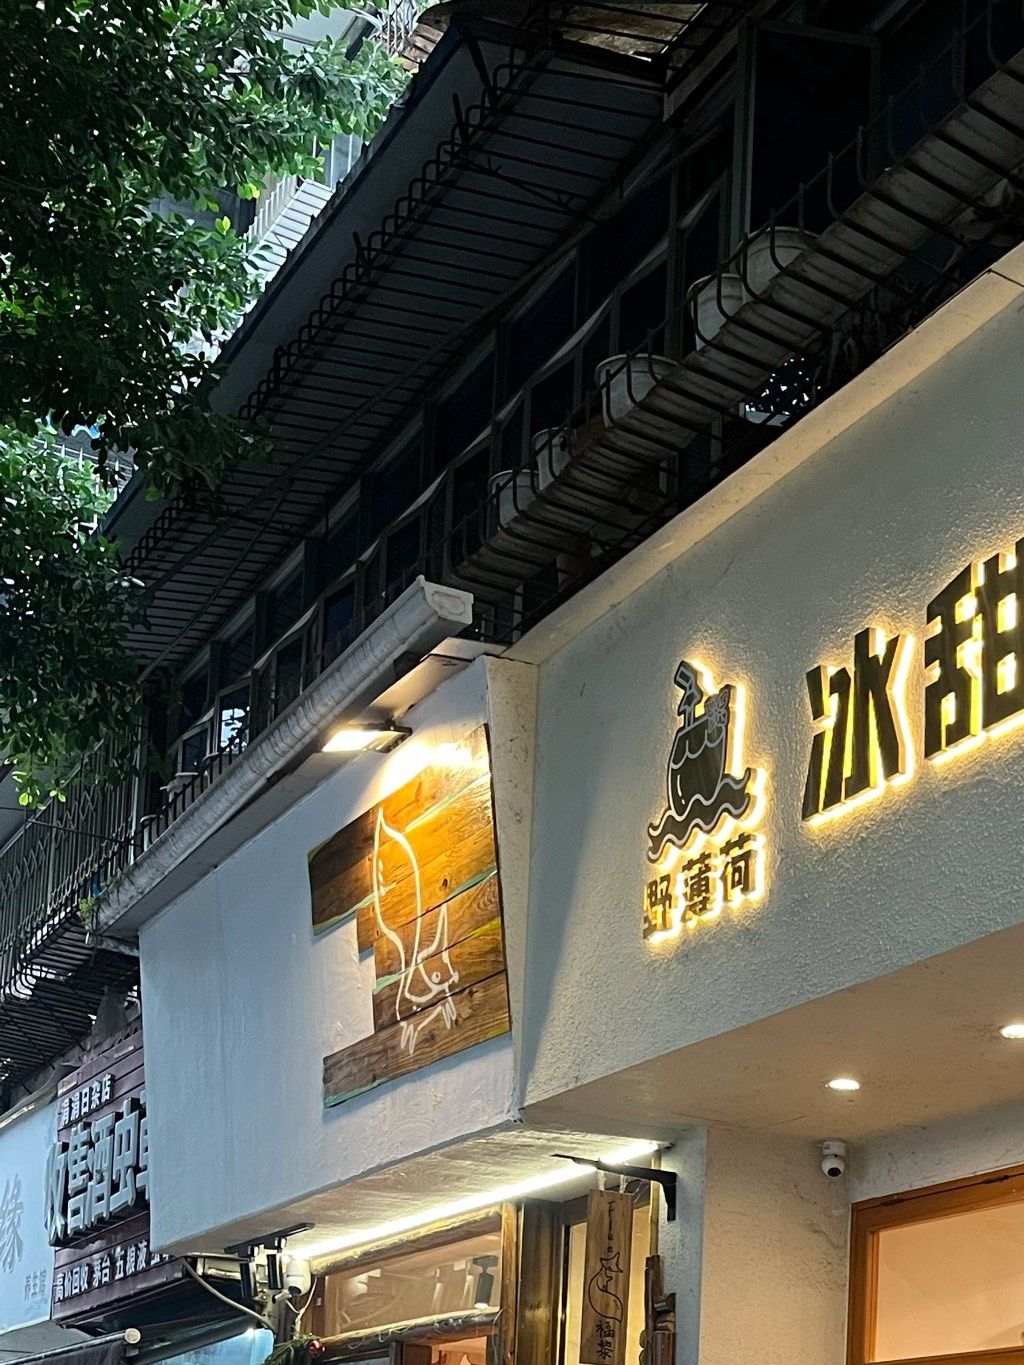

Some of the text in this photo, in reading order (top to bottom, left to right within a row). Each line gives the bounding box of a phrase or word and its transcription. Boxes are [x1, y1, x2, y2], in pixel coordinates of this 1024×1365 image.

[642, 831, 756, 939] 野薄荷
[54, 1262, 89, 1301] 高价回收
